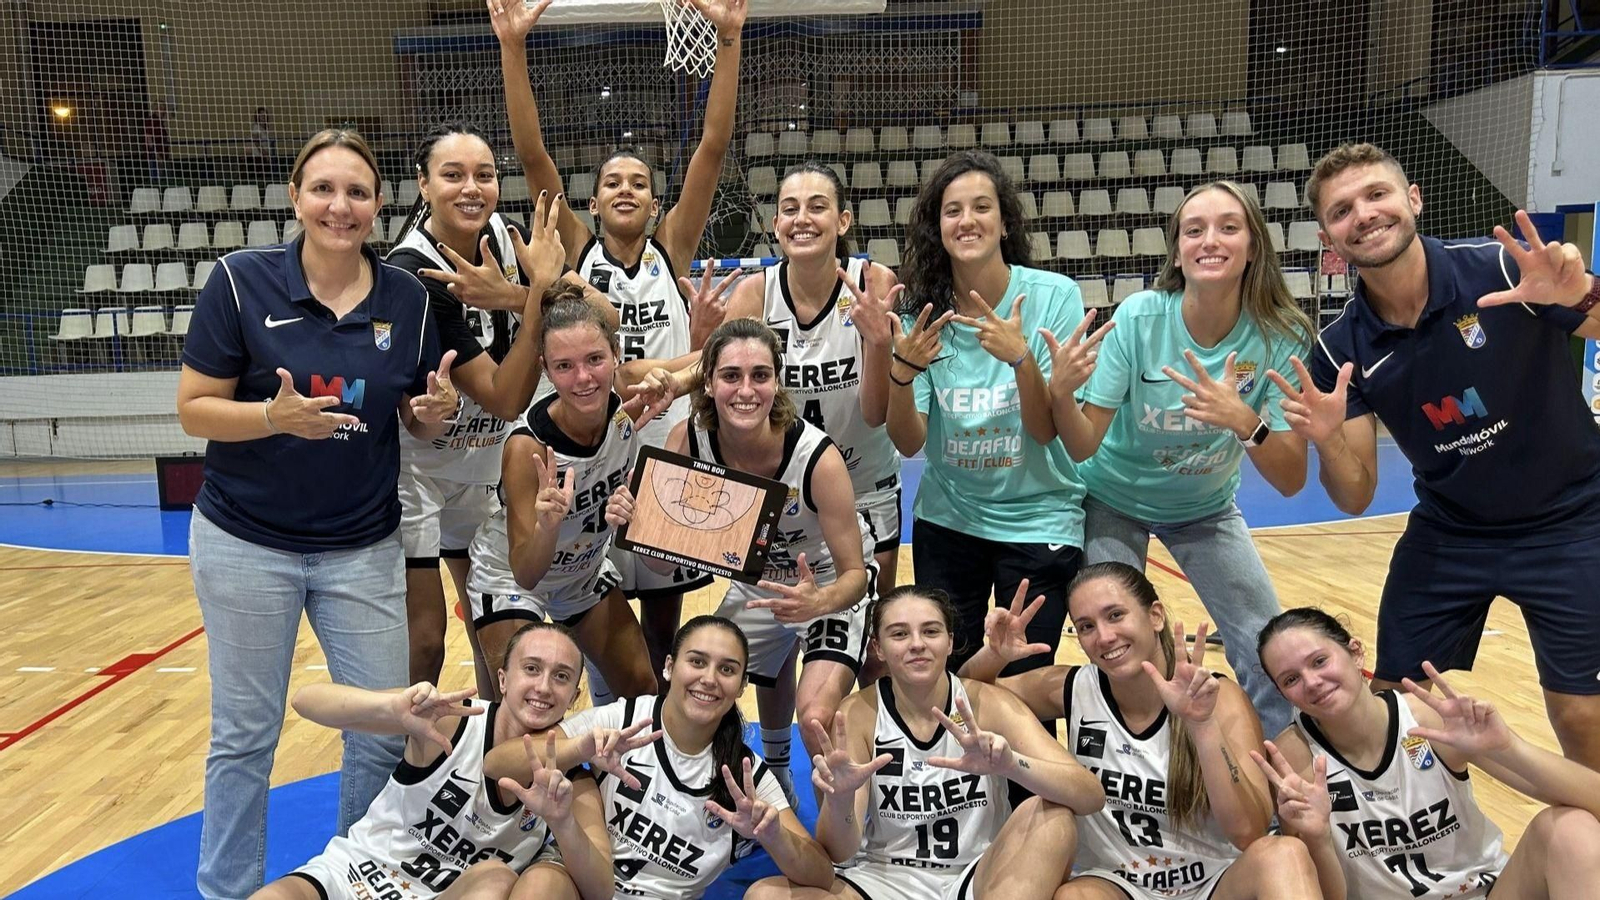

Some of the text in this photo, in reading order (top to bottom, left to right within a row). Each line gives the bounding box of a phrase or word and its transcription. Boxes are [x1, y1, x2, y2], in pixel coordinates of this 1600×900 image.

[814, 379, 859, 394] BALONCESTO
[468, 436, 496, 448] CLUB
[946, 435, 1022, 455] DESAFIO
[693, 461, 726, 476] TRINI BOU
[957, 456, 1014, 469] FIT CLUB
[632, 545, 650, 556] XEREZ
[650, 551, 665, 560] CLUB
[665, 554, 697, 569] DEPORTIVO
[697, 563, 733, 578] BALONCESTO
[806, 618, 849, 652] 25
[878, 773, 987, 812] XEREZ
[1083, 765, 1166, 808] ERE
[897, 813, 936, 821] DEPORTIVO
[937, 800, 988, 817] BALONCESTO
[1336, 797, 1457, 851] XEREZ
[408, 828, 423, 842] CLUB
[420, 840, 455, 862] DEPORTIVO
[608, 801, 706, 876] XEREZ
[915, 817, 959, 859] 19
[1111, 810, 1164, 848] 13
[1405, 822, 1461, 851] BALONCESTO
[648, 853, 695, 879] BALONCESTO
[1384, 853, 1446, 899] 71
